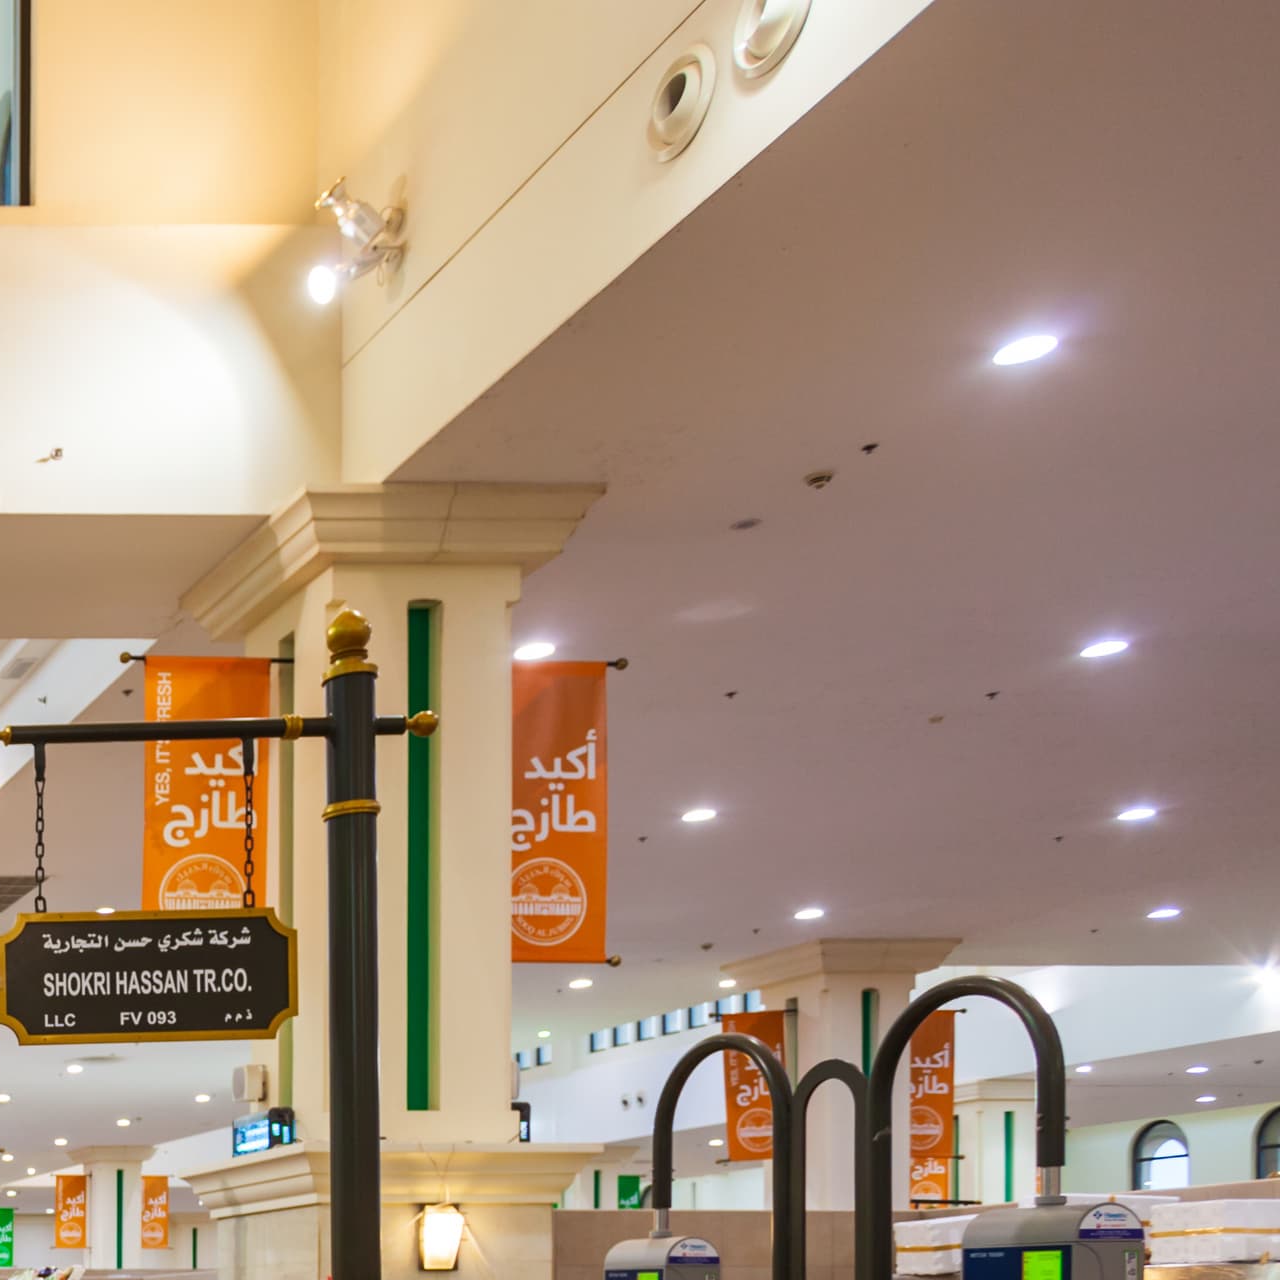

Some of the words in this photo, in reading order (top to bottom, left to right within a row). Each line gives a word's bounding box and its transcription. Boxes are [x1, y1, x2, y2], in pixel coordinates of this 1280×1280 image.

[524, 728, 598, 791] أكيد
[154, 768, 171, 807] YES,
[163, 790, 258, 848] طازج
[43, 933, 109, 953] التجارية
[114, 936, 152, 952] حسن
[157, 928, 204, 952] شكري
[208, 926, 251, 948] شركة
[43, 972, 111, 997] SHOKRI
[115, 969, 189, 996] HASSAN
[193, 967, 253, 993] TR.CO.
[44, 1013, 77, 1027] LLC
[120, 1011, 142, 1025] FV
[147, 1011, 177, 1025] 093
